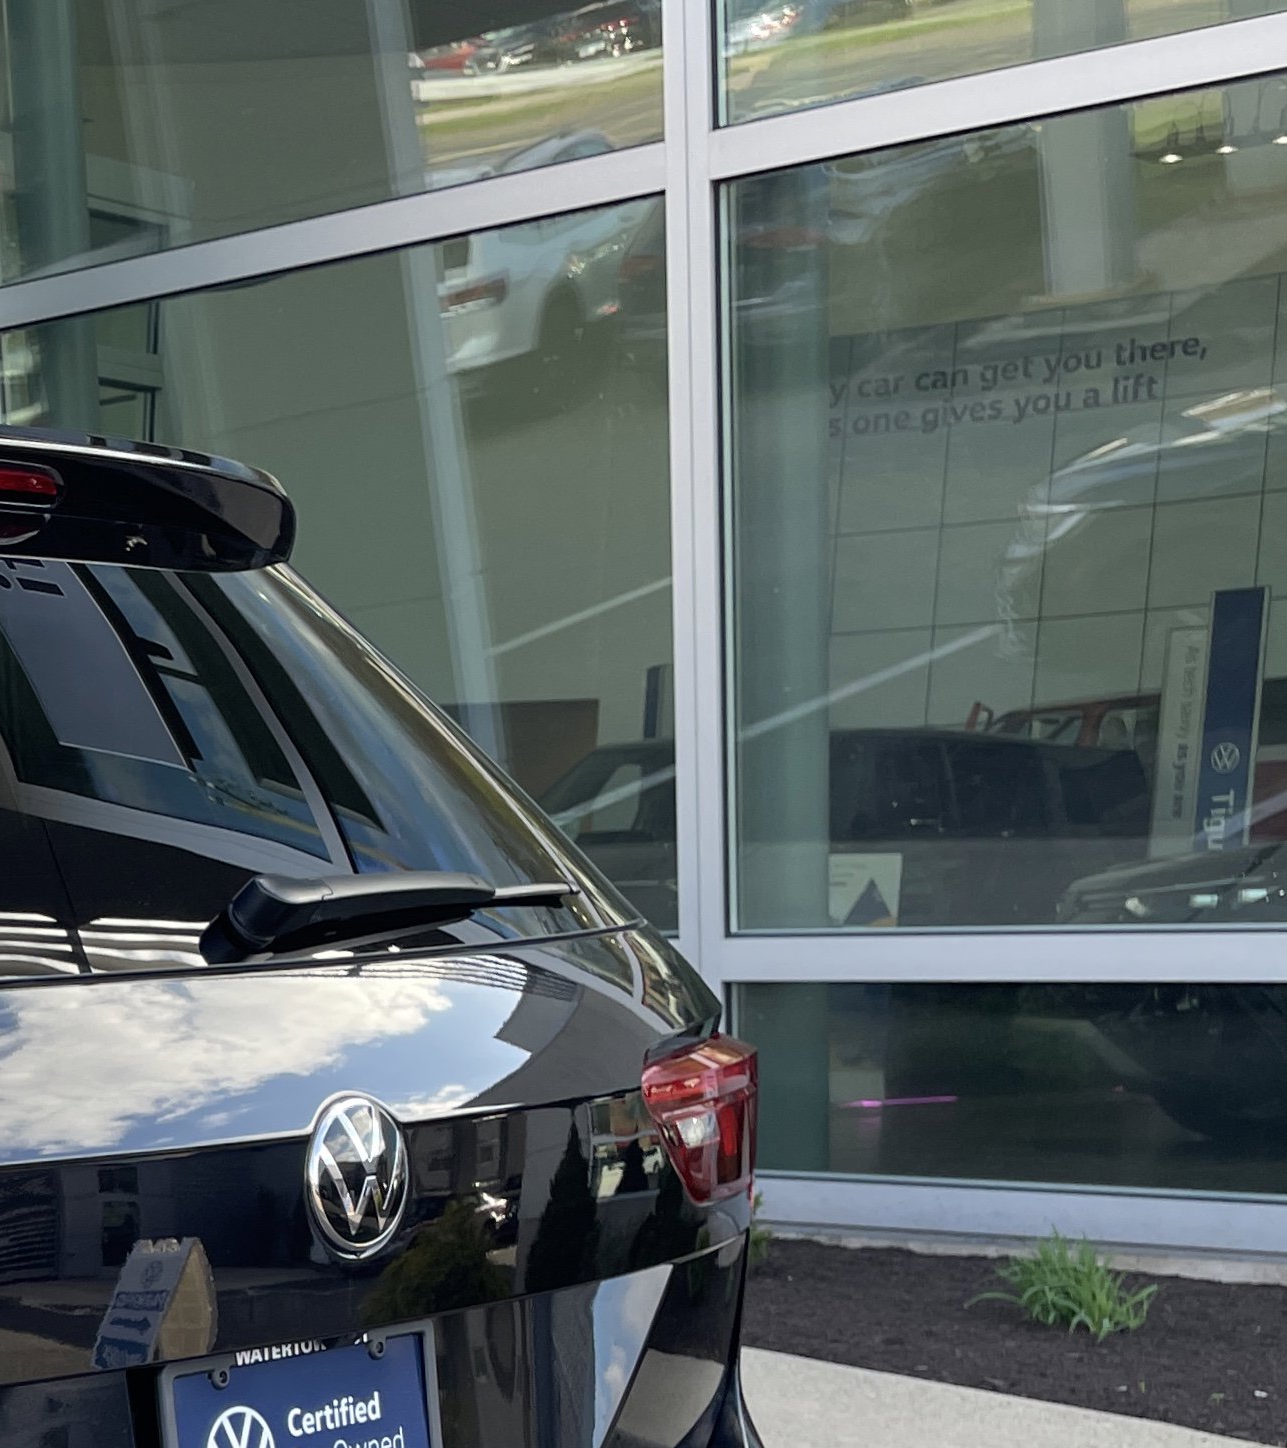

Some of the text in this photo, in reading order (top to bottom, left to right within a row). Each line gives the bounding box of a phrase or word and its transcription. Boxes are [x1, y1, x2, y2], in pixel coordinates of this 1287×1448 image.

[858, 373, 905, 398] car
[914, 367, 969, 392] can
[980, 355, 1033, 392] get
[1043, 349, 1102, 384] you
[1115, 337, 1207, 367] there,
[852, 410, 911, 435] one
[921, 399, 1004, 434] gives
[1013, 391, 1072, 424] you
[1083, 387, 1100, 409] a
[1112, 373, 1159, 404] lift
[1203, 788, 1235, 850] Tigu
[287, 1390, 382, 1437] Certified
